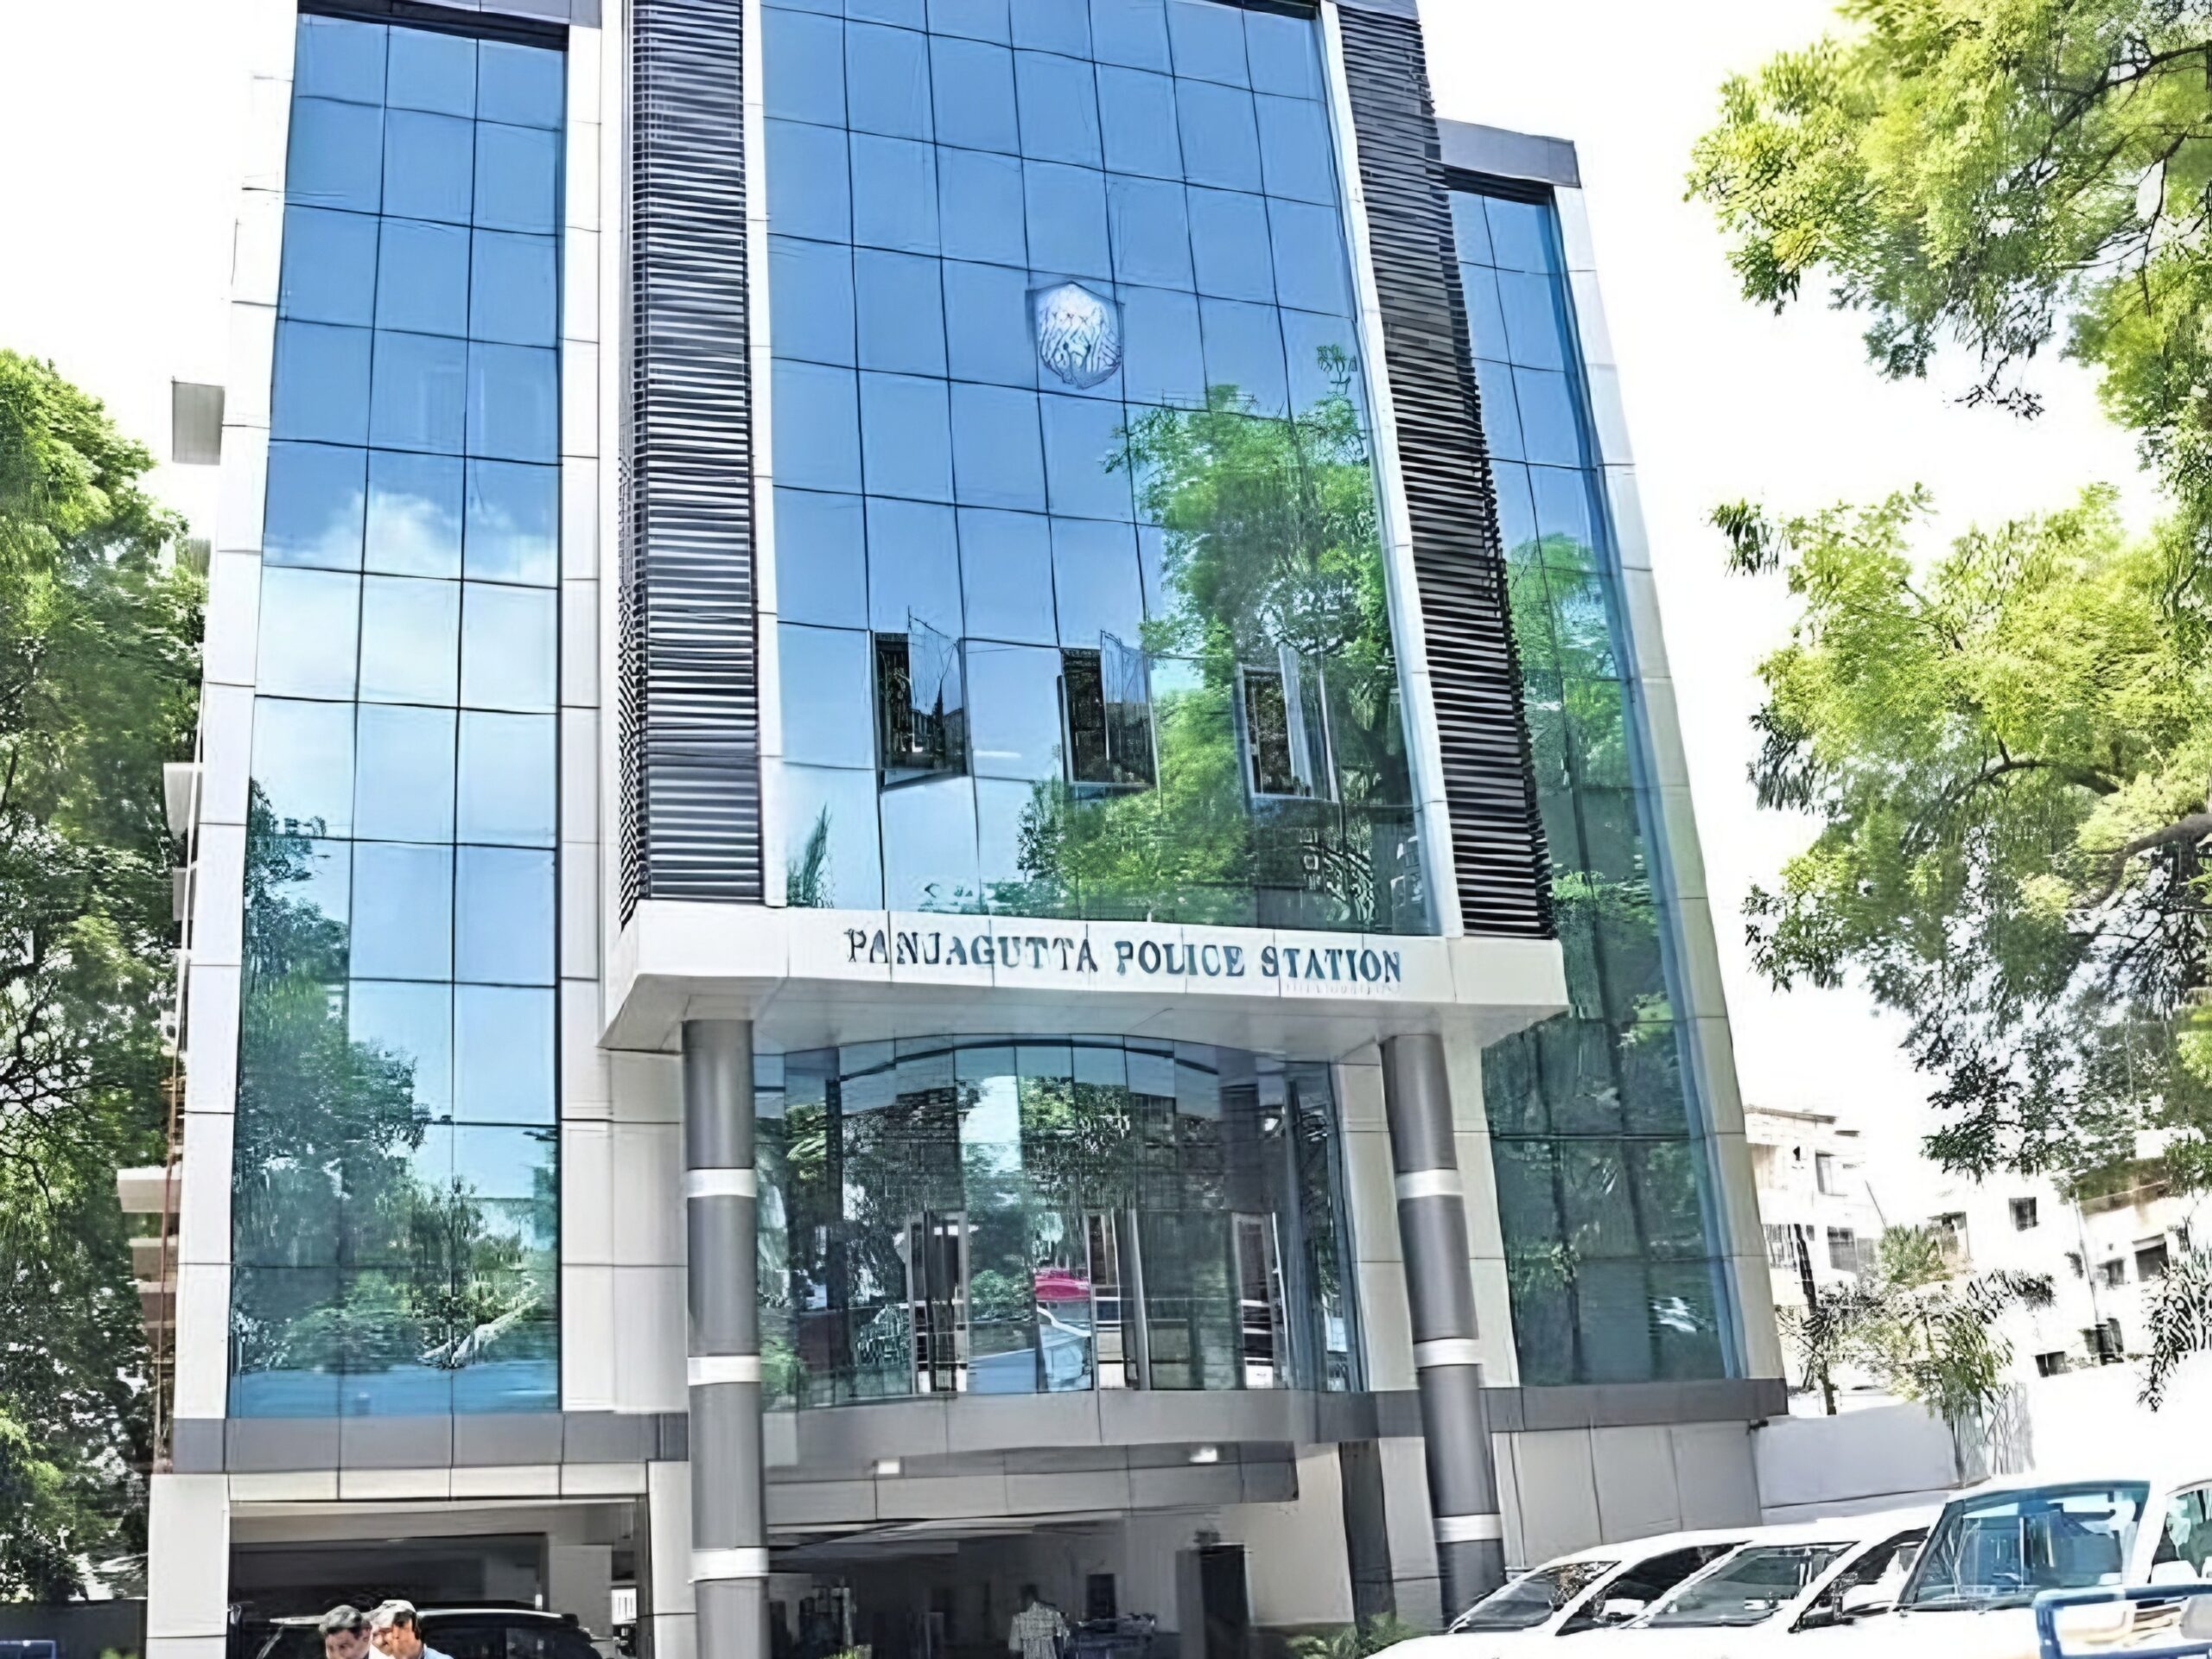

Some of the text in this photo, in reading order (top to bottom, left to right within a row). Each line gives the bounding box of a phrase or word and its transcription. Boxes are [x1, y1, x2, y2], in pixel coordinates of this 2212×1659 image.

[843, 928, 1401, 982] PANJAGUTTA POLICE STATION
